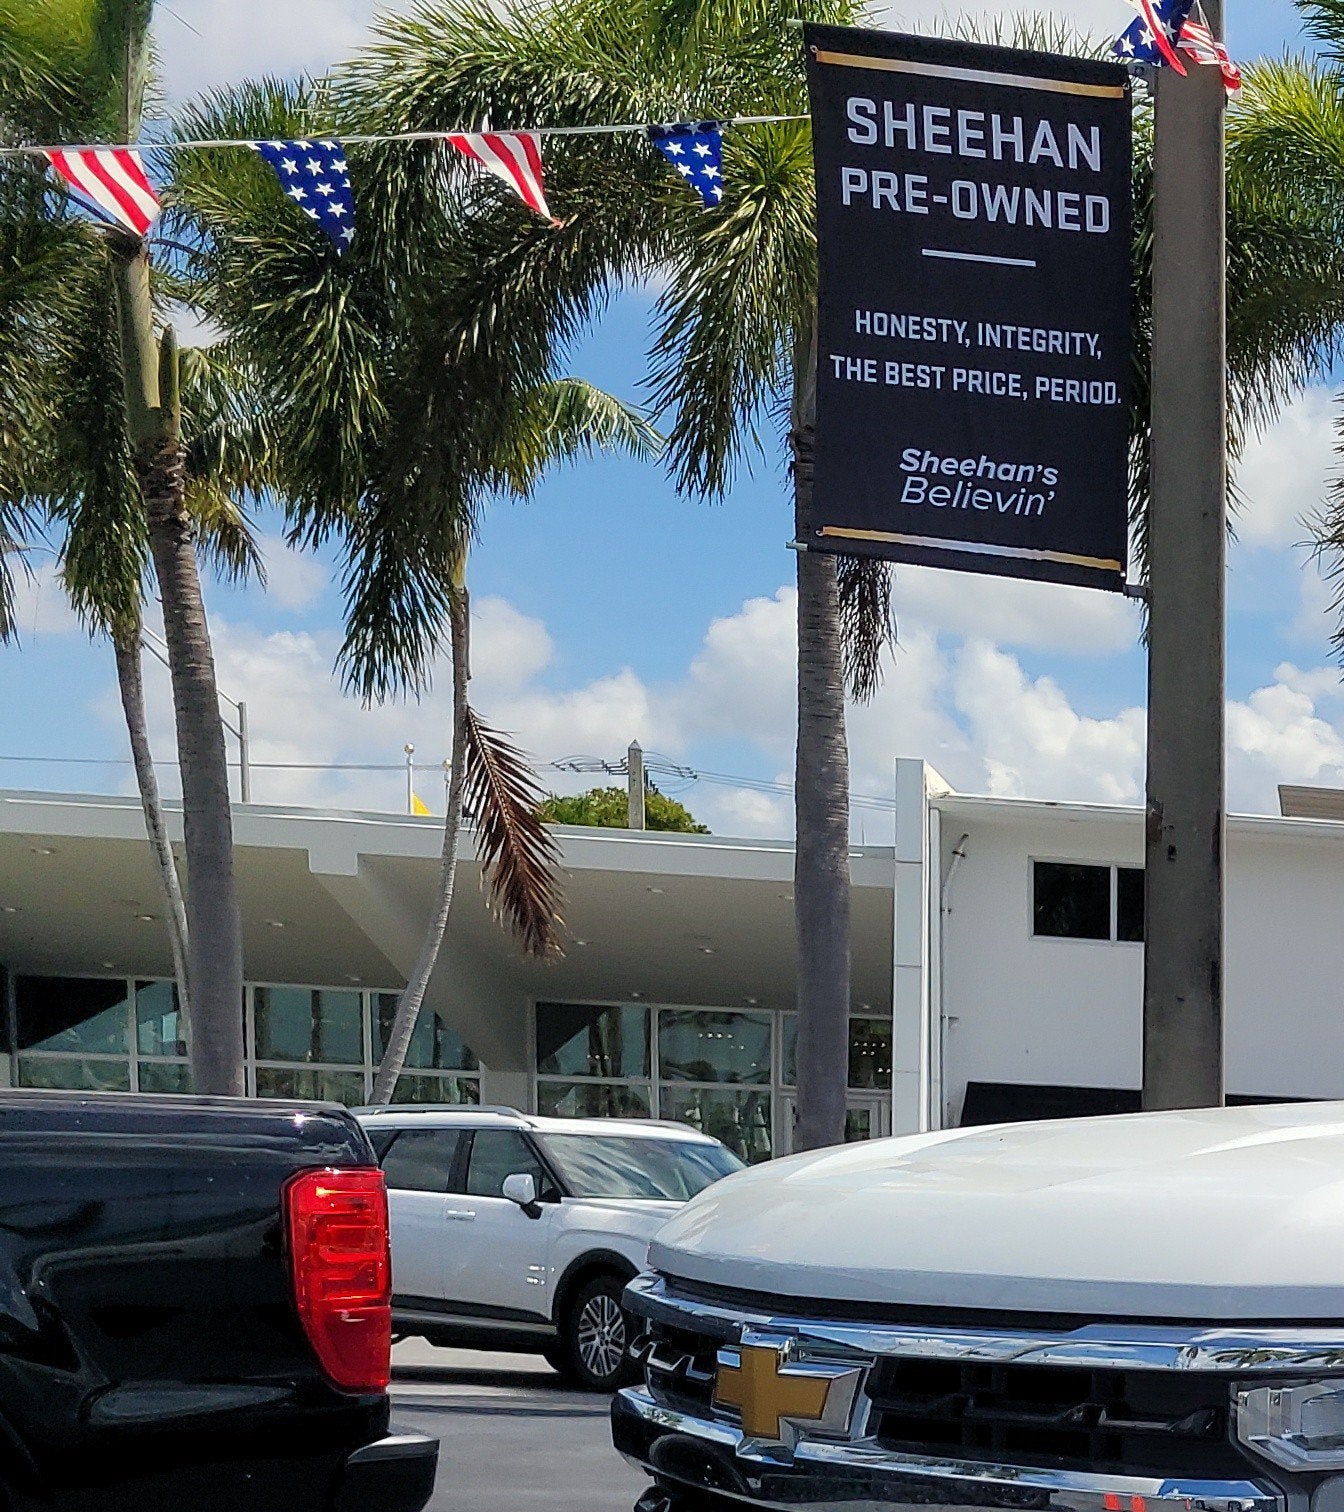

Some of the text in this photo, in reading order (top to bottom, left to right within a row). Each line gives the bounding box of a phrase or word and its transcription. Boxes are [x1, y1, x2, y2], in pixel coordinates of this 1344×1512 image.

[846, 96, 1101, 172] SHEEHAN
[841, 166, 1110, 233] PRE-OWNED
[855, 309, 1102, 360] HONESTY, INTEGRITY,
[830, 354, 1122, 405] THE BEST PRICE, PERIOD.
[900, 448, 1059, 486] Sheehan's
[901, 475, 1055, 516] Believin'
